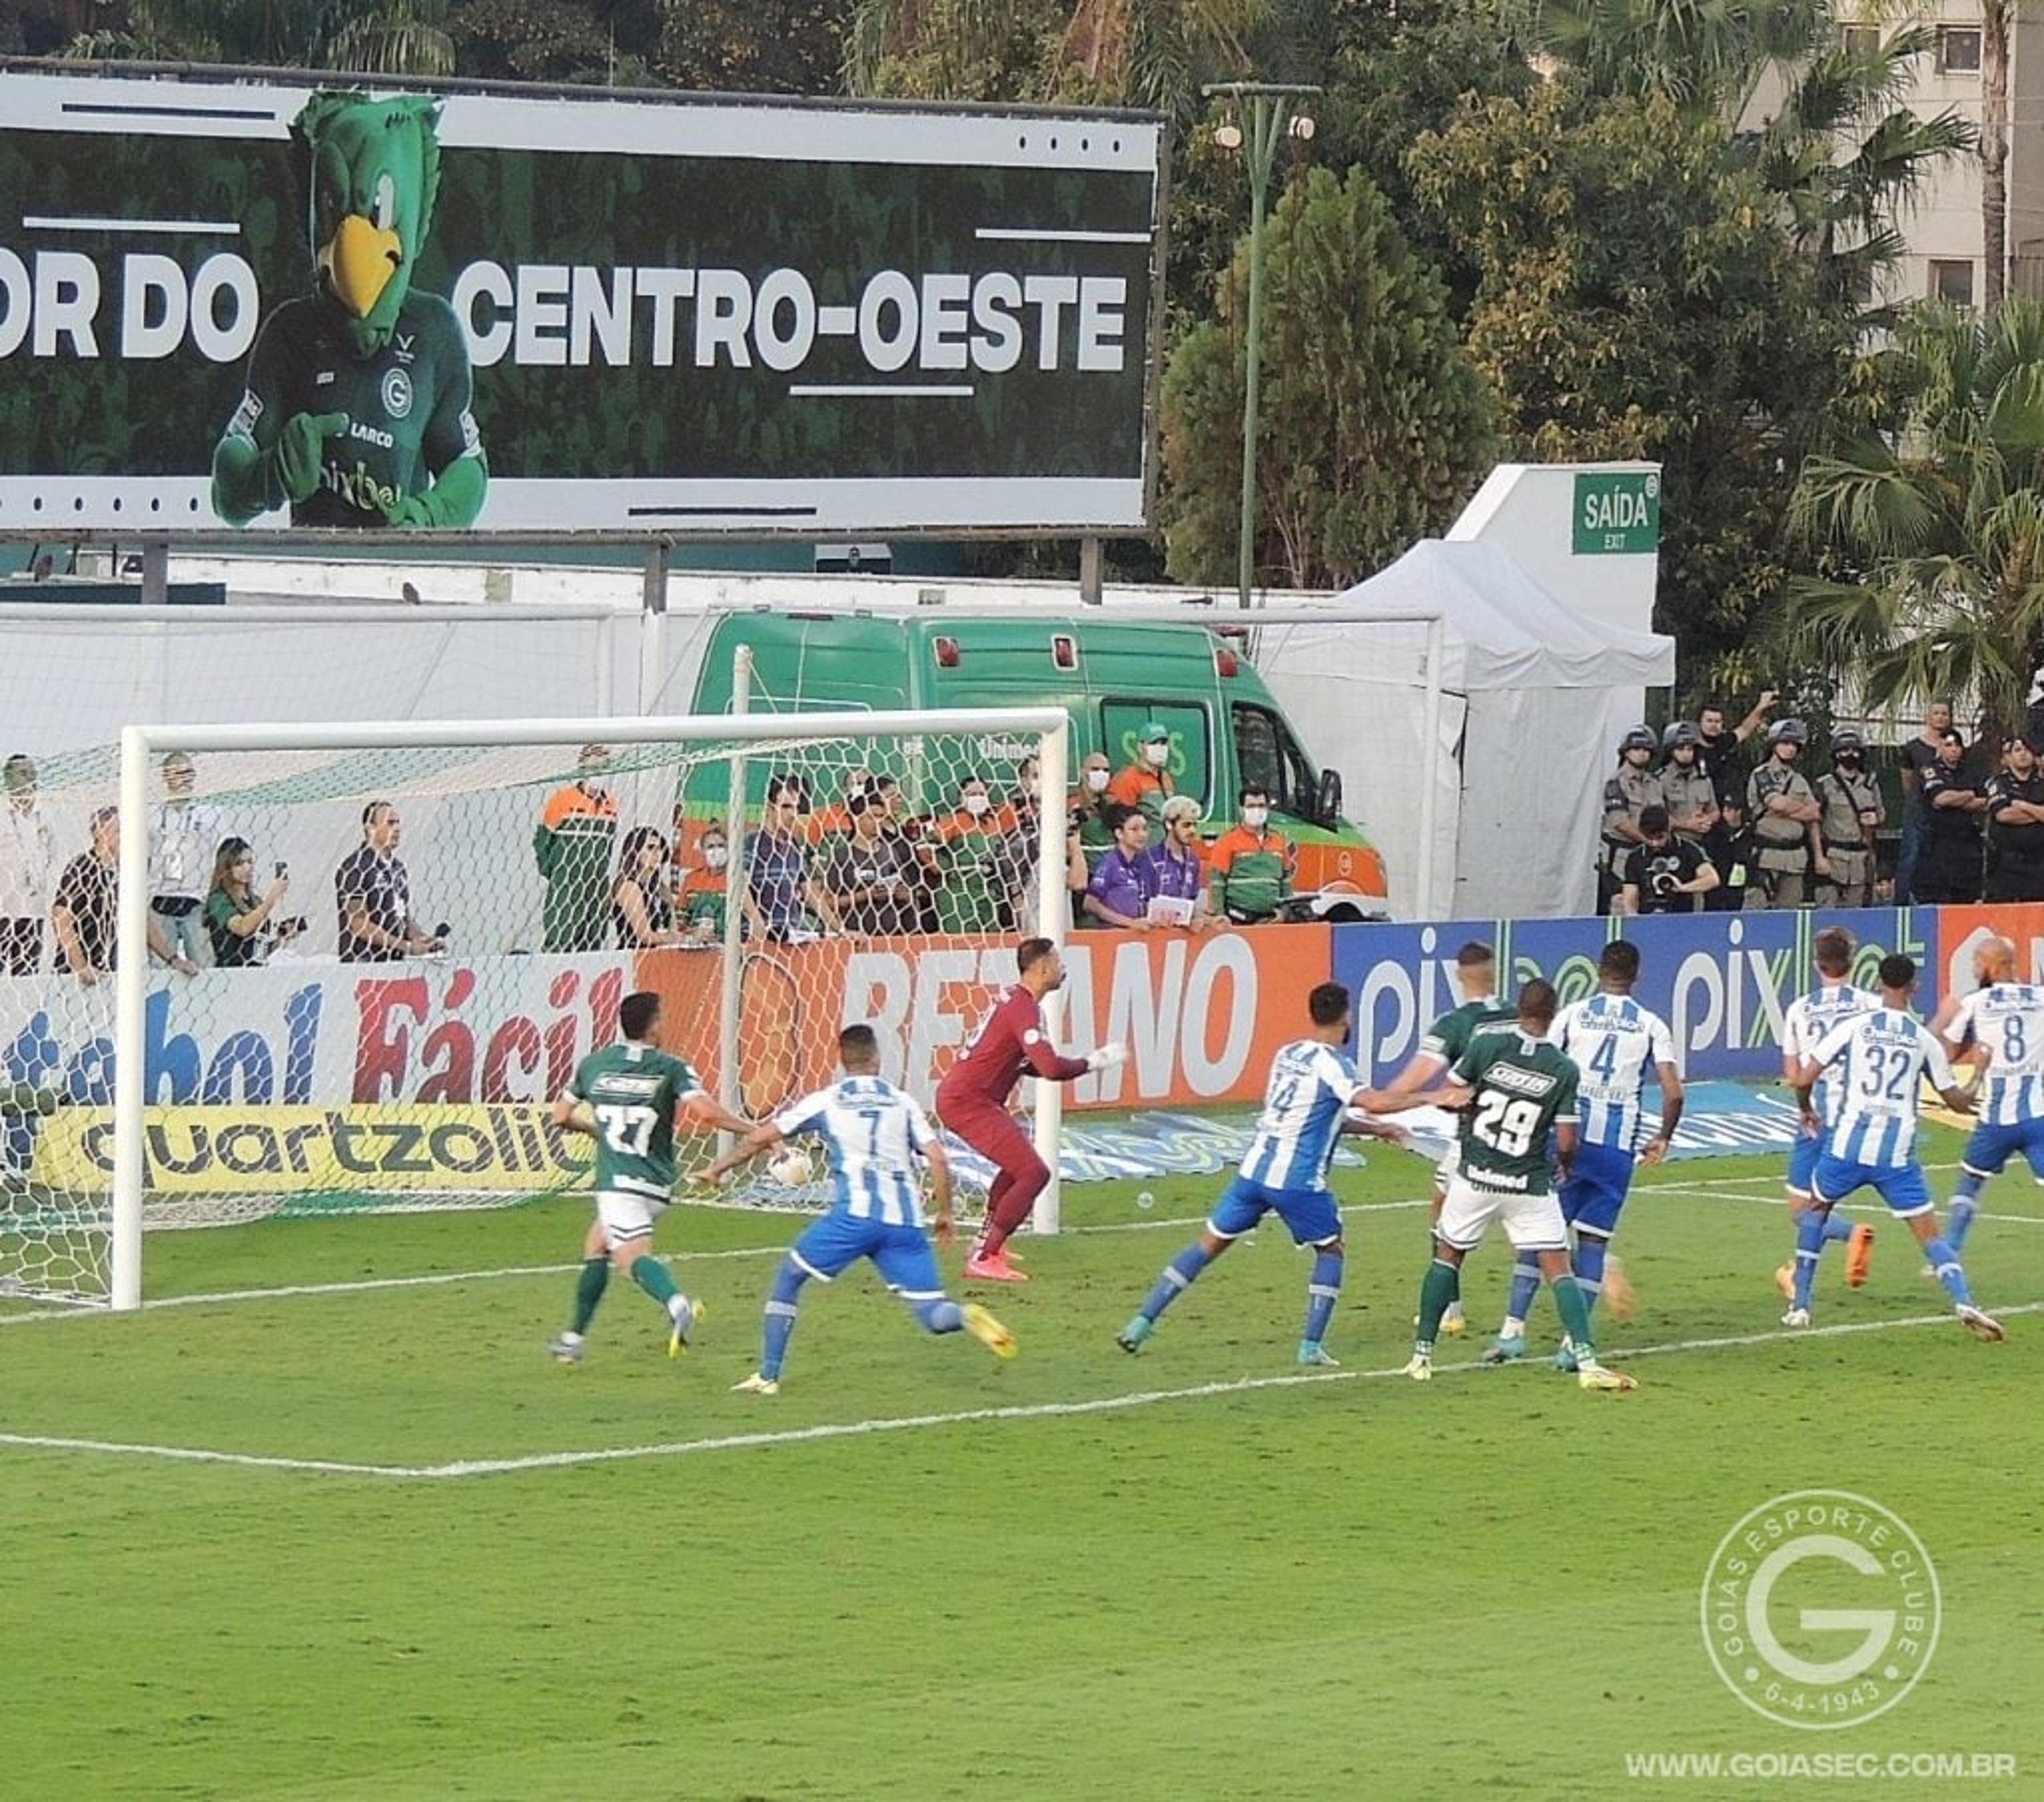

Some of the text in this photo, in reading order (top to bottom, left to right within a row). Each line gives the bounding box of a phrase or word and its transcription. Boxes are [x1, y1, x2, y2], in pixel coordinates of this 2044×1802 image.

[121, 253, 260, 362] DO
[451, 260, 1126, 373] CENTRO-OESTE
[350, 423, 393, 448] LARCO
[1584, 485, 1649, 530] SAÍDA
[1604, 534, 1626, 550] EXIT
[1122, 730, 1186, 777] SS
[1358, 919, 1623, 1092] pibe
[351, 967, 623, 1106] Fácil
[1589, 1034, 1618, 1086] 4
[2004, 1015, 2025, 1063] 8
[1861, 1046, 1910, 1101] 32
[81, 1106, 594, 1188] quartzolit
[859, 1110, 881, 1159] 7
[1472, 1089, 1543, 1157] 29
